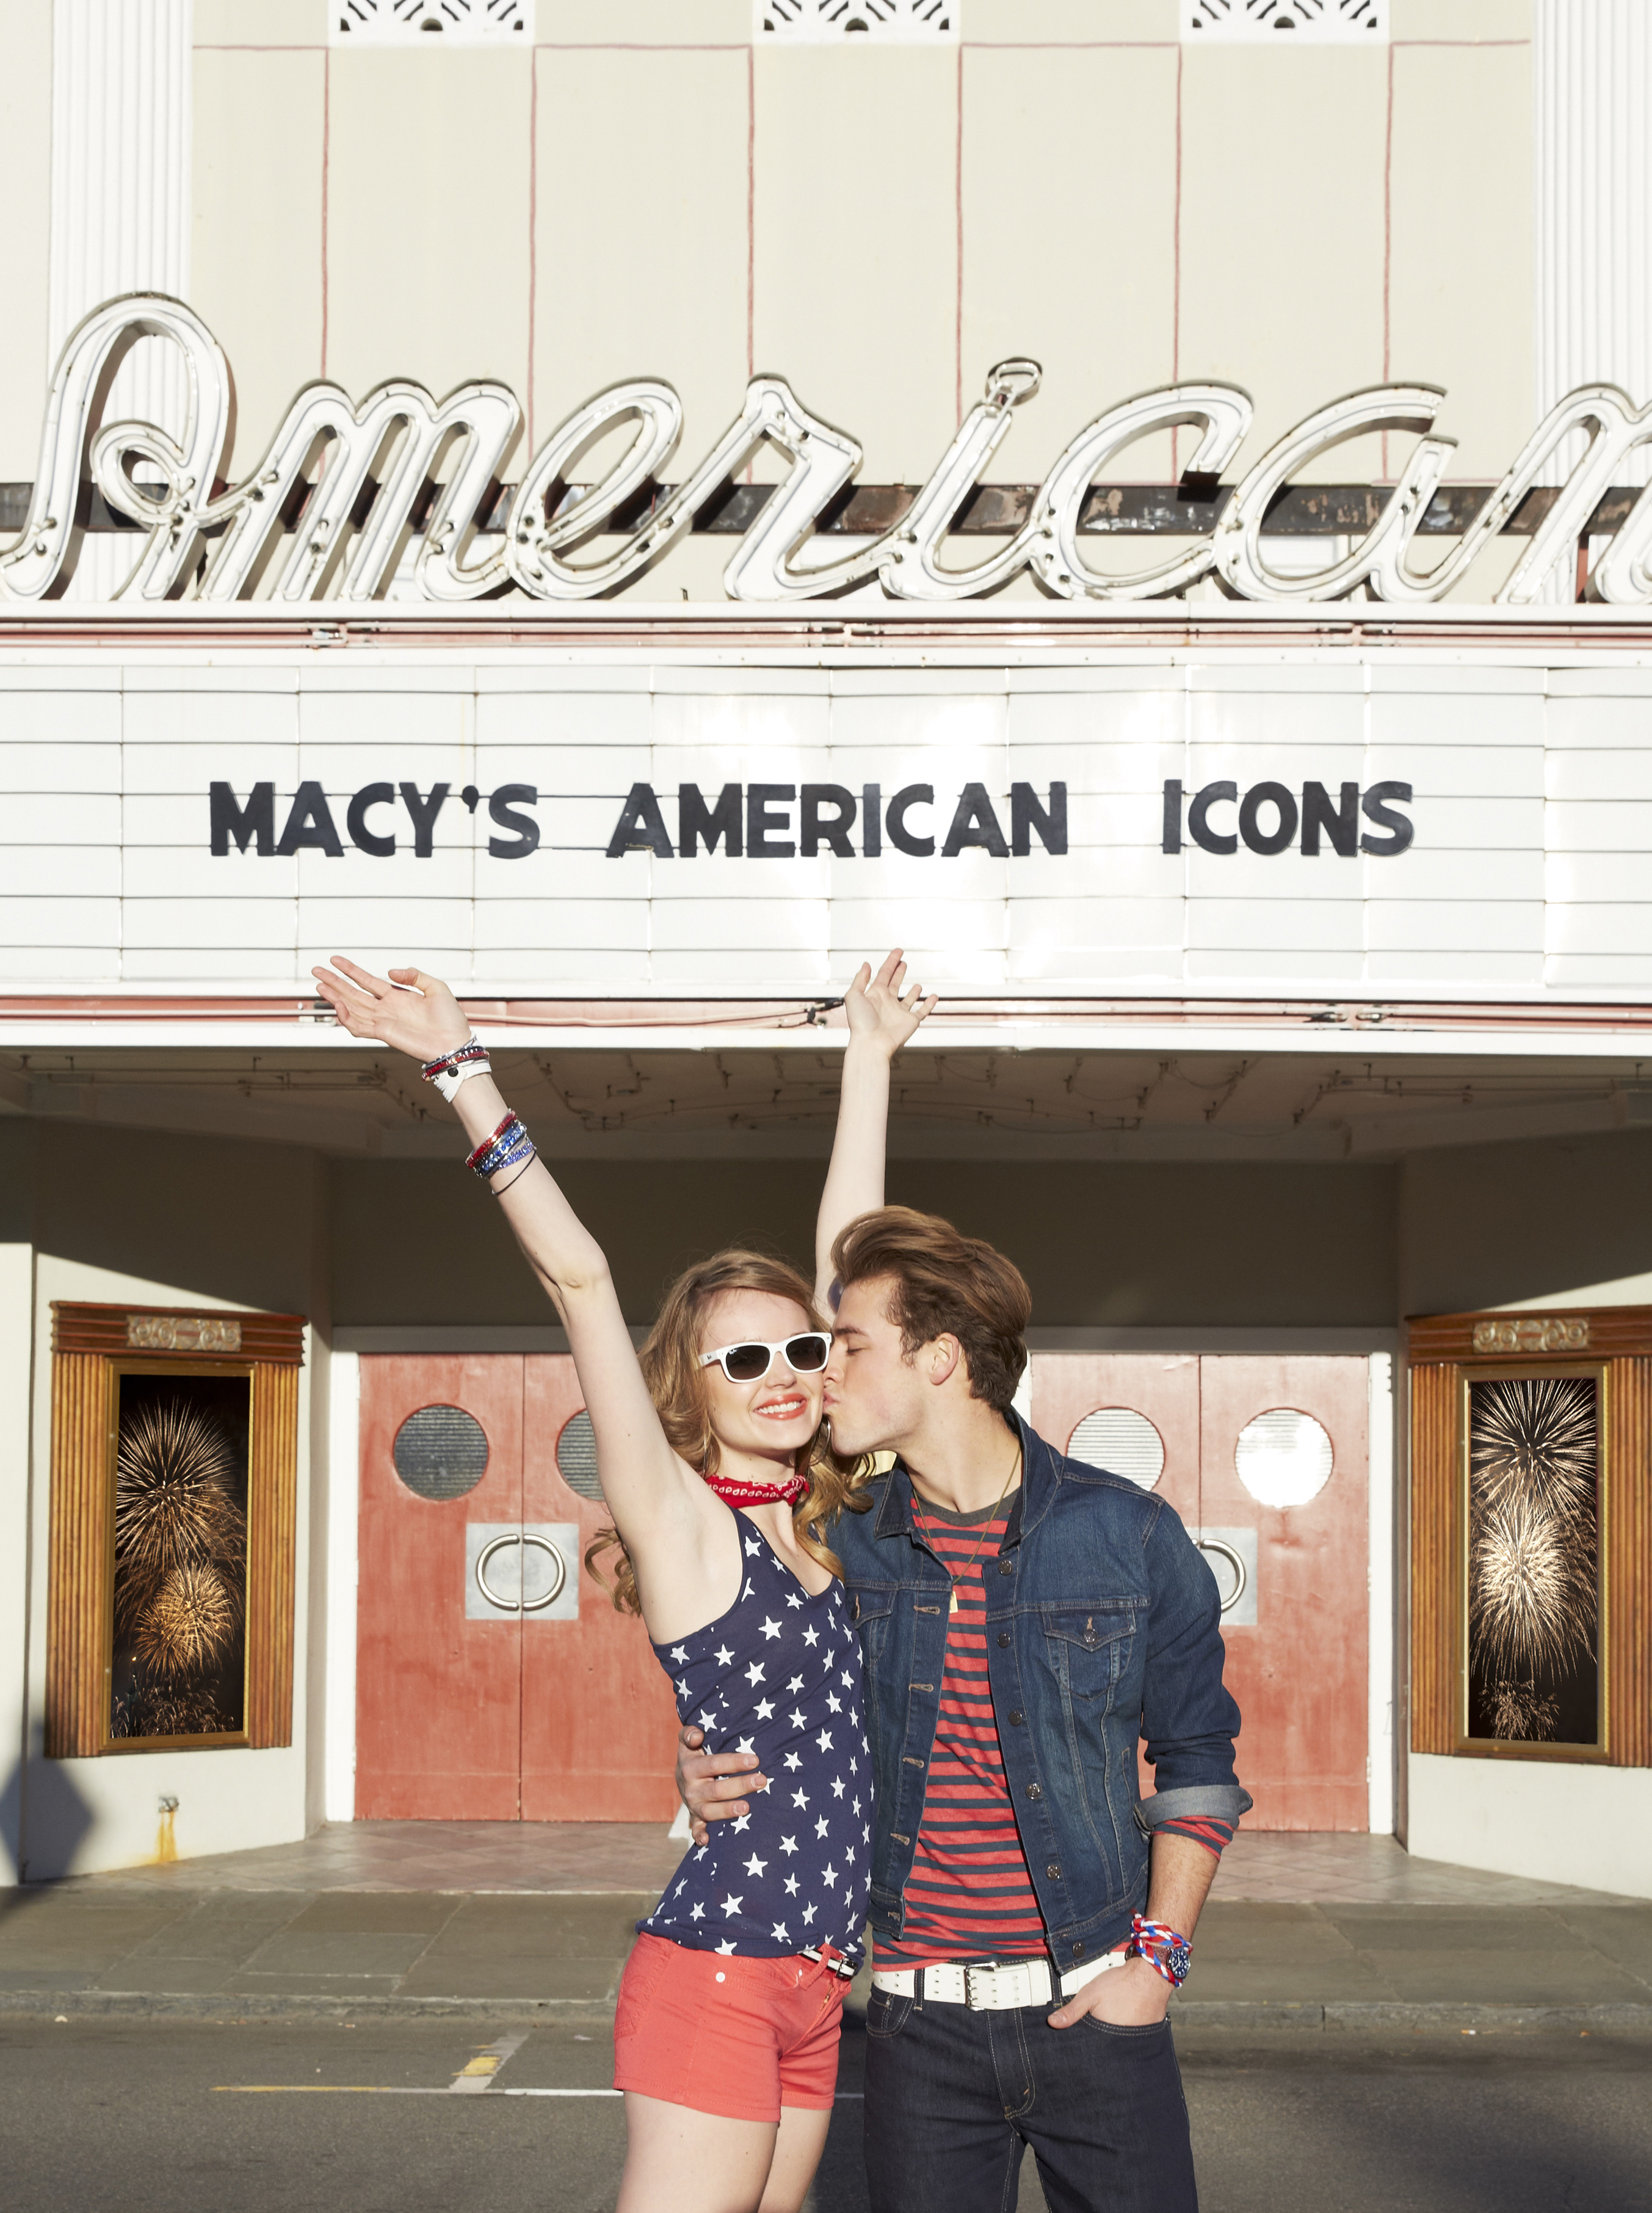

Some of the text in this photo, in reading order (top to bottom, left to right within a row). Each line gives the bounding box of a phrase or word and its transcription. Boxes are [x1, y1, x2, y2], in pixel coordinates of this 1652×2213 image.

[210, 780, 1413, 859] MACY'S AMERICAN ICONS
